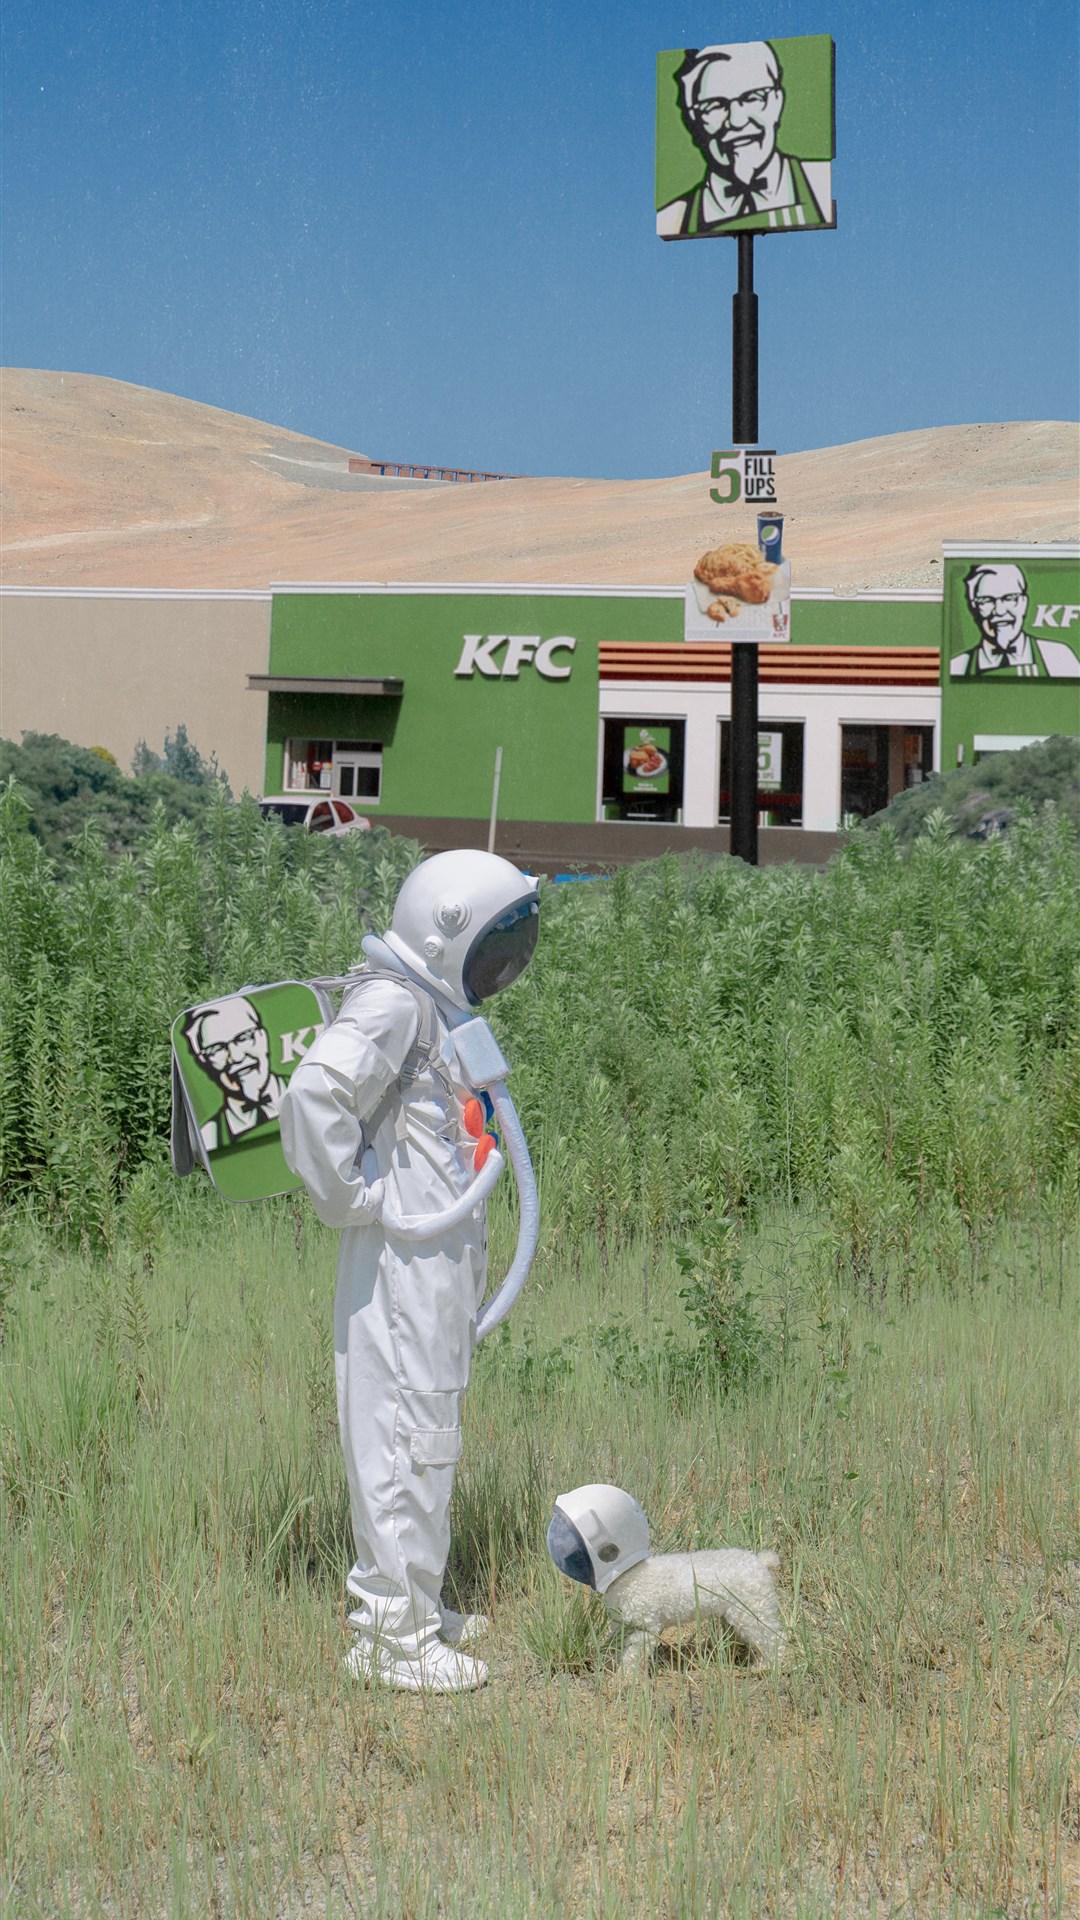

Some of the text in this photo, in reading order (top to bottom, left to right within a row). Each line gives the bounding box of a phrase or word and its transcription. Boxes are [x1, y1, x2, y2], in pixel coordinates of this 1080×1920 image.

[710, 451, 741, 504] 5
[745, 458, 776, 476] FILL
[745, 478, 775, 496] UPS
[453, 634, 577, 678] KFC
[280, 1024, 324, 1064] K
